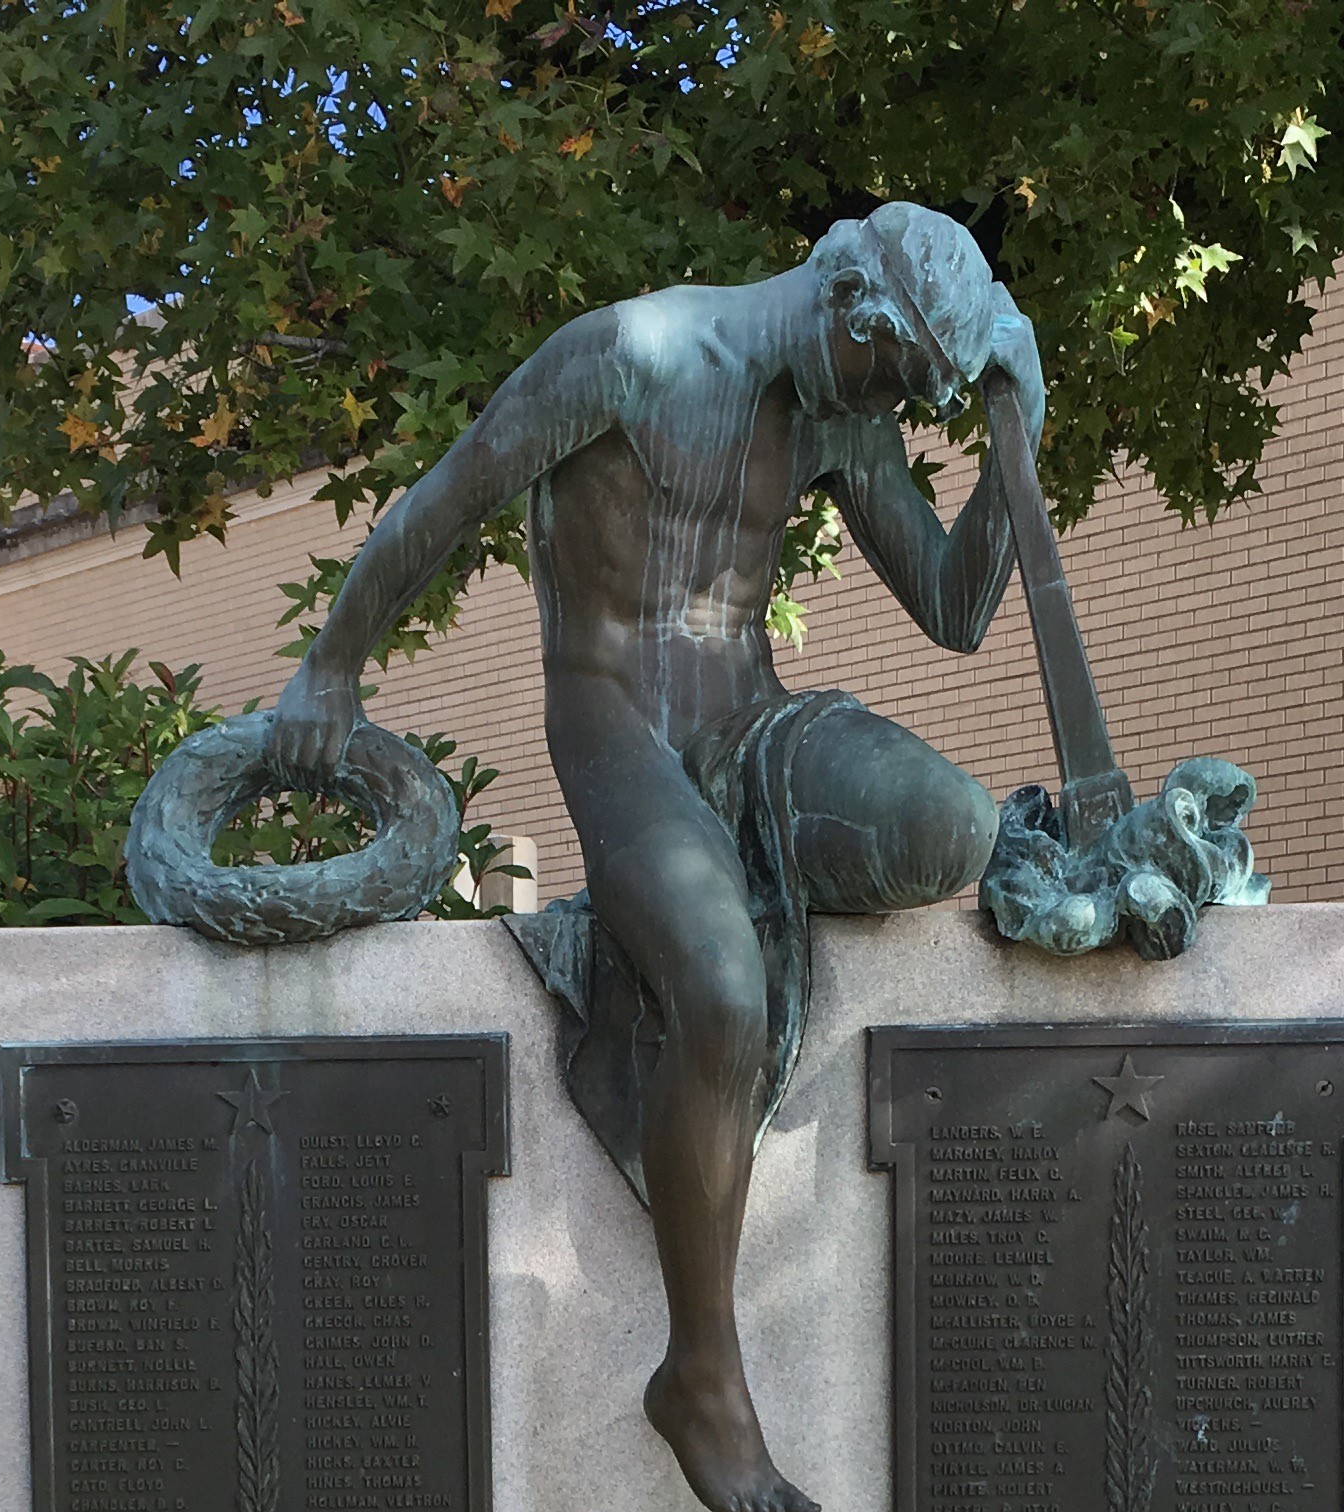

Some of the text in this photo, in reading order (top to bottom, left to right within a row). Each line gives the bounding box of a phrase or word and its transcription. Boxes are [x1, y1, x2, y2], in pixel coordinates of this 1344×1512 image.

[149, 1138, 194, 1151] JAMES
[357, 1135, 401, 1148] LLOYD
[356, 1154, 391, 1167] JETT
[1000, 1167, 1041, 1180] FELIX
[1235, 1164, 1291, 1177] ALFRED
[1302, 1164, 1314, 1177] L.
[352, 1174, 394, 1187] LOUIS
[404, 1174, 416, 1186] E.
[374, 1195, 420, 1207] JAMES
[1011, 1188, 1057, 1201] HARRY
[205, 1197, 217, 1211] L.
[139, 1218, 196, 1231] ROBERT
[204, 1217, 217, 1230] L.
[341, 1215, 387, 1228] OSCAR
[132, 1238, 190, 1251] SAMUEL
[995, 1251, 1054, 1264] LEMUEL
[1249, 1291, 1320, 1304] REGINALD
[1031, 1314, 1075, 1327] BOYCE
[1084, 1314, 1096, 1327] A.
[1248, 1311, 1297, 1324] JAMES
[1268, 1332, 1324, 1345] LUTHER
[353, 1354, 394, 1368] OWEN
[1270, 1354, 1313, 1367] HARRY
[1322, 1353, 1335, 1366] E.
[365, 1375, 411, 1387] ELMER
[1247, 1375, 1304, 1389] ROBERT
[1047, 1398, 1093, 1411] LUCIAN
[1003, 1420, 1041, 1432] JOHN
[365, 1475, 422, 1488] THOMAS
